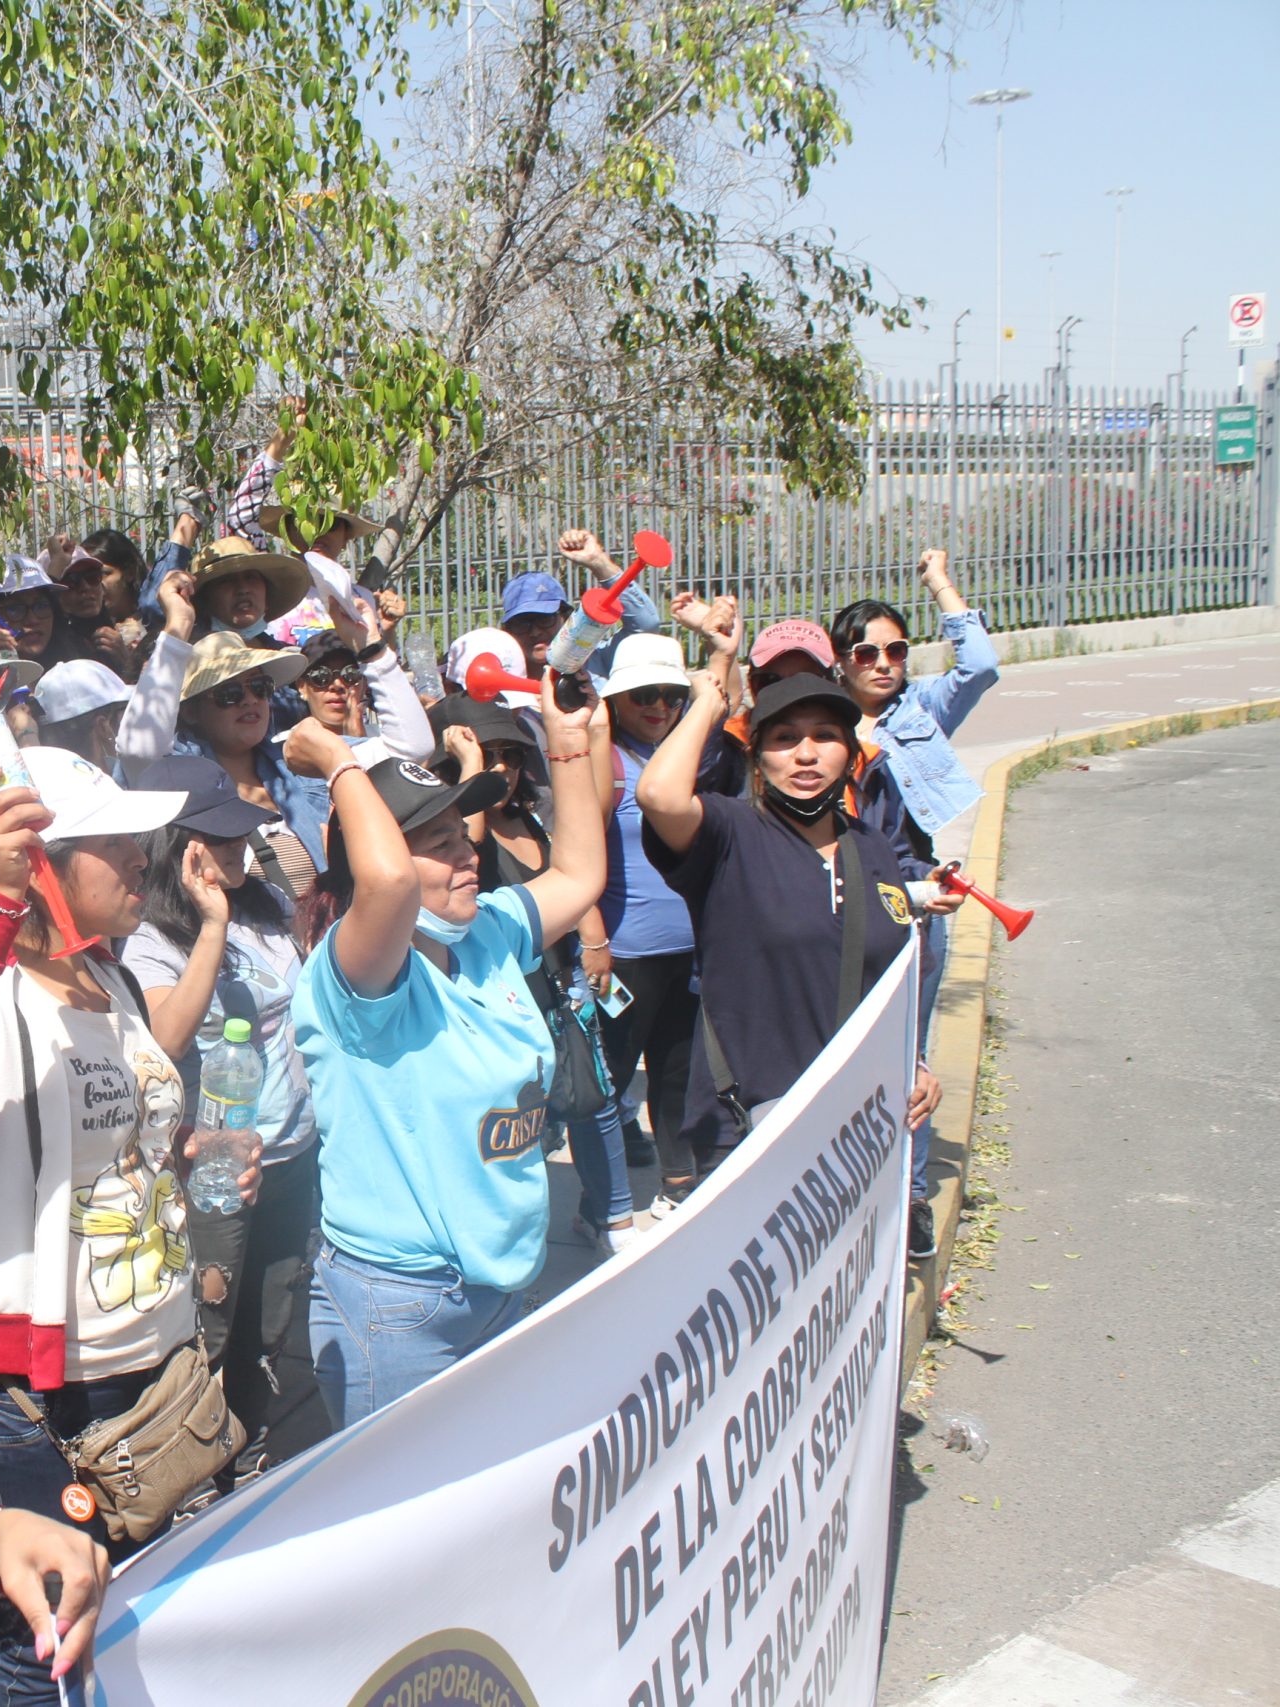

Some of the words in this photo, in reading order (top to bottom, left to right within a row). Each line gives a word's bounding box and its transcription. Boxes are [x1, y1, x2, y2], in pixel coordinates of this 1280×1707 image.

[69, 1056, 124, 1079] Beauty
[82, 1105, 134, 1131] within
[84, 1081, 132, 1110] found
[101, 1075, 114, 1088] is
[548, 1288, 739, 1573] SINDICATO
[728, 1237, 781, 1347] DE
[614, 1510, 665, 1652] DE
[673, 1453, 718, 1576] LA
[723, 1204, 878, 1506] COORPORACIÓN
[722, 1473, 789, 1650] PERU
[792, 1439, 806, 1523] Y
[810, 1283, 889, 1493] SERVICIOS
[731, 1475, 850, 1707] TRACORPS
[793, 1563, 861, 1707] EQUIPA
